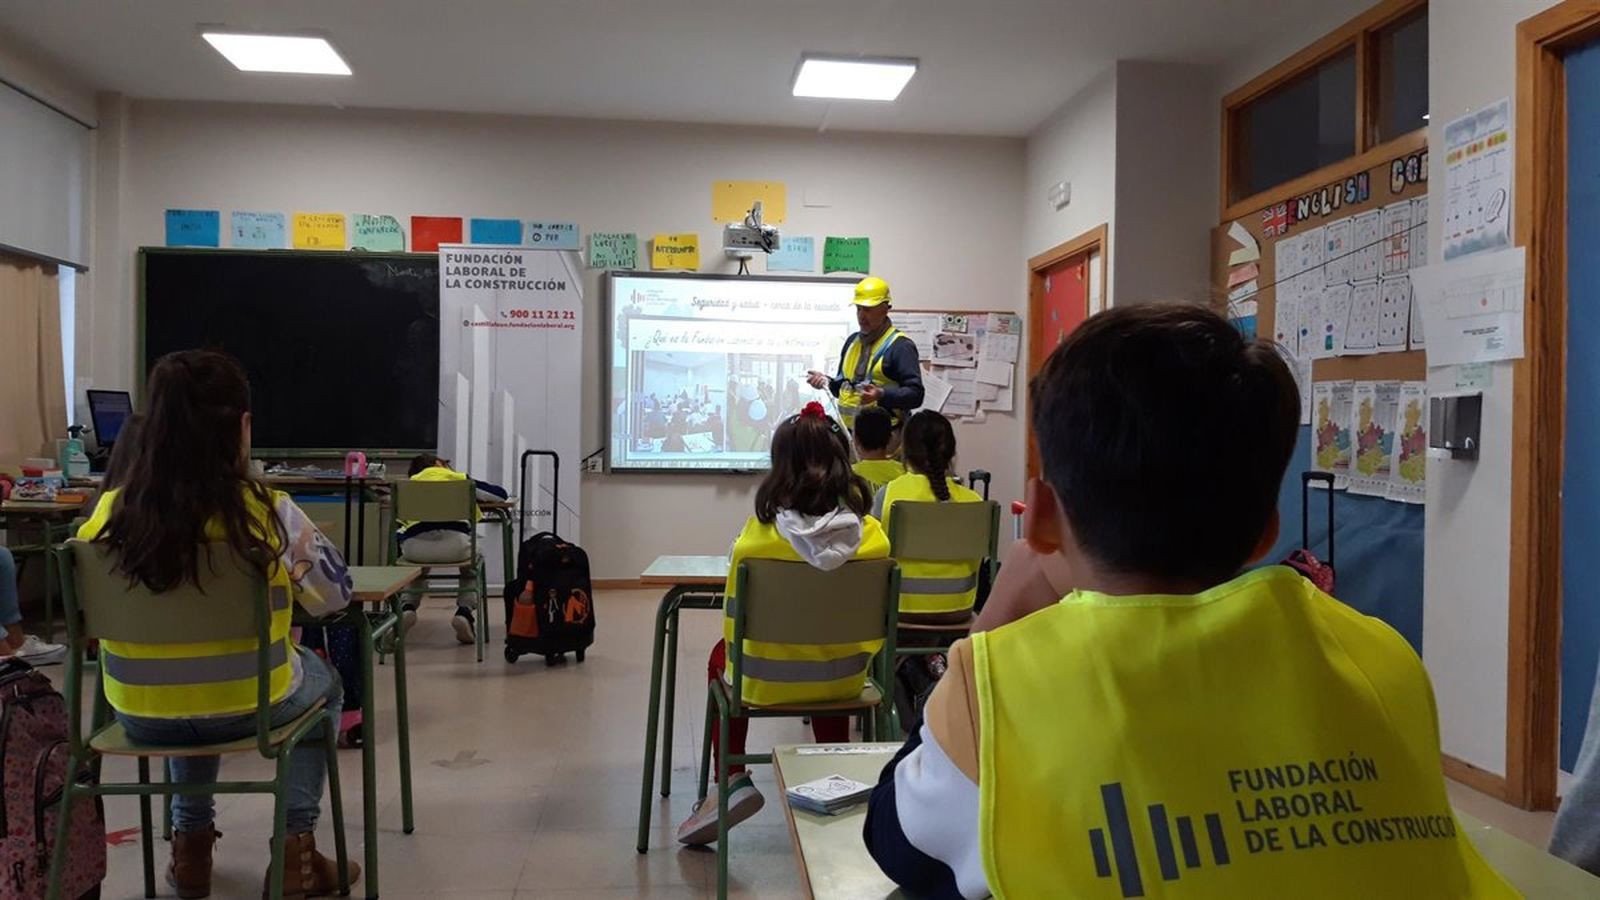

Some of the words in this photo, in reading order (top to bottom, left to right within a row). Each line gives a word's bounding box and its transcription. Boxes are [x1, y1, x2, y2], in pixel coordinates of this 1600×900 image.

[1286, 171, 1370, 226] ENGLISH
[446, 251, 523, 265] FUNDACIÓN
[445, 266, 506, 278] LABORAL
[509, 267, 527, 278] DE
[445, 279, 461, 289] LA
[465, 278, 566, 291] CONSTRUCCIÓN
[509, 310, 529, 319] 900
[532, 311, 544, 319] 11
[547, 311, 559, 320] 21
[562, 311, 575, 320] 21
[1228, 751, 1379, 793] FUNDACIÓN
[1236, 789, 1363, 823] LABORAL
[1244, 827, 1284, 854] DE
[1290, 821, 1326, 850] LA
